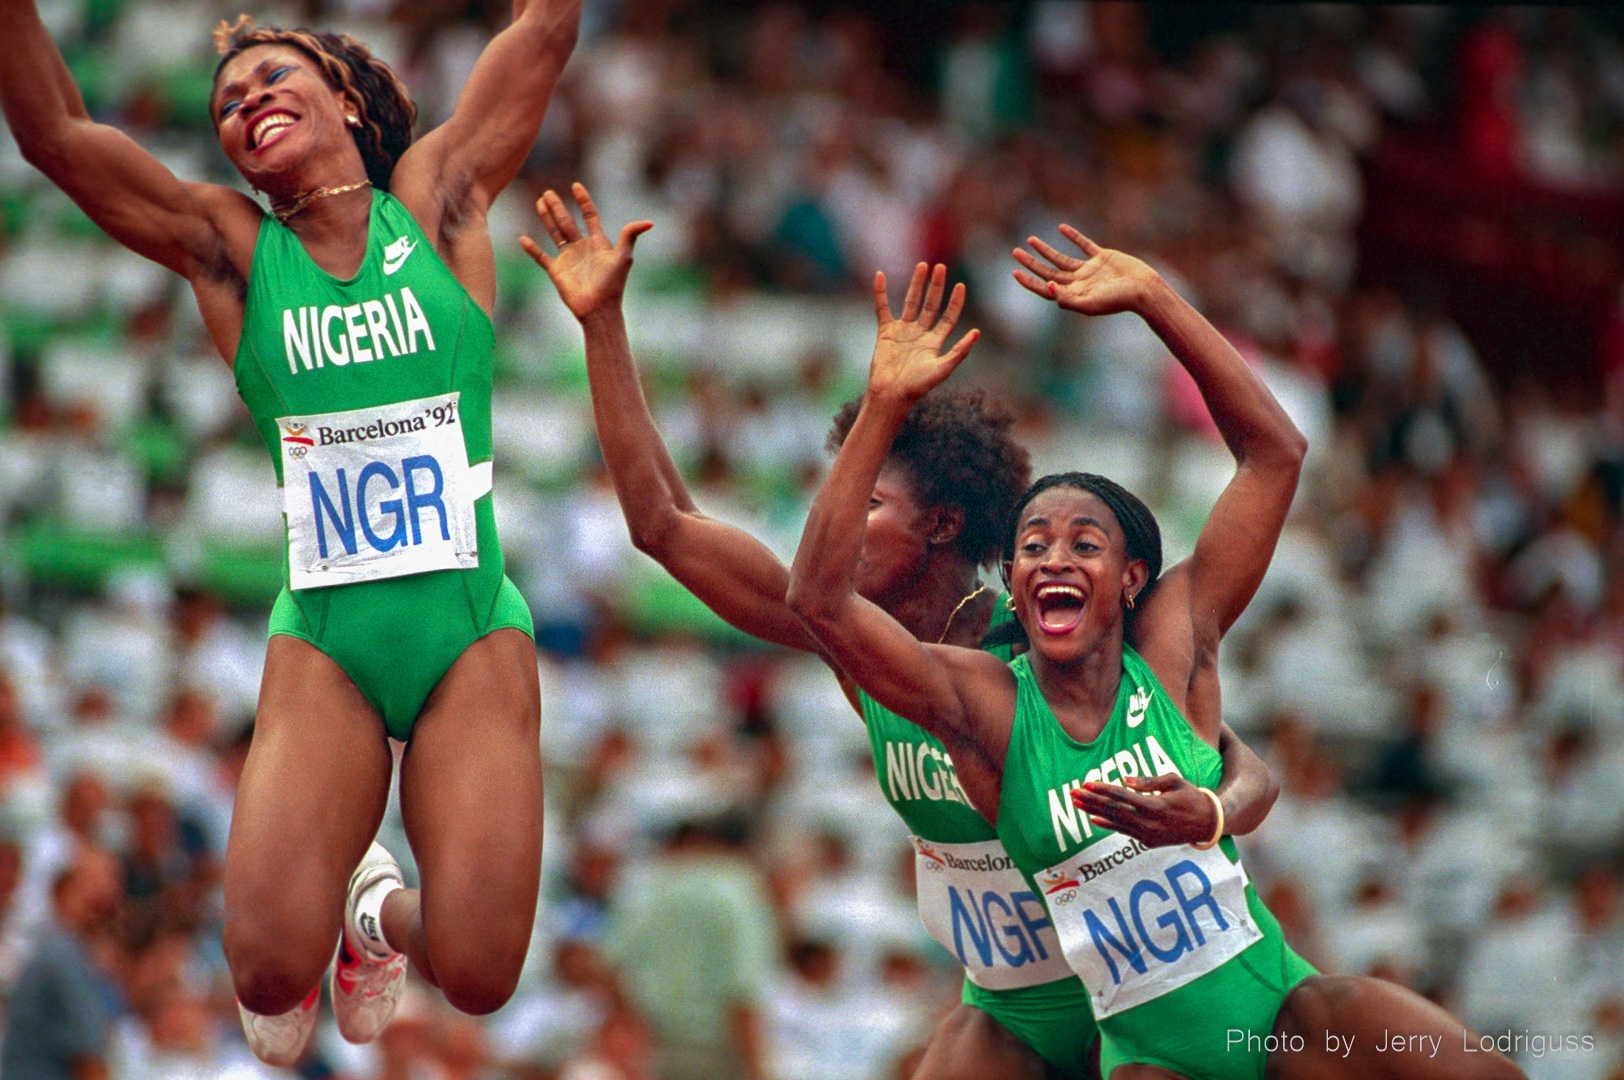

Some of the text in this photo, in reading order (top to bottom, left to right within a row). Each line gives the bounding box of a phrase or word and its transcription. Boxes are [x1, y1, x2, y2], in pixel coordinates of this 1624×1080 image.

[283, 287, 436, 375] NIGERIA
[308, 454, 450, 559] NGR
[1083, 859, 1230, 985] NGR
